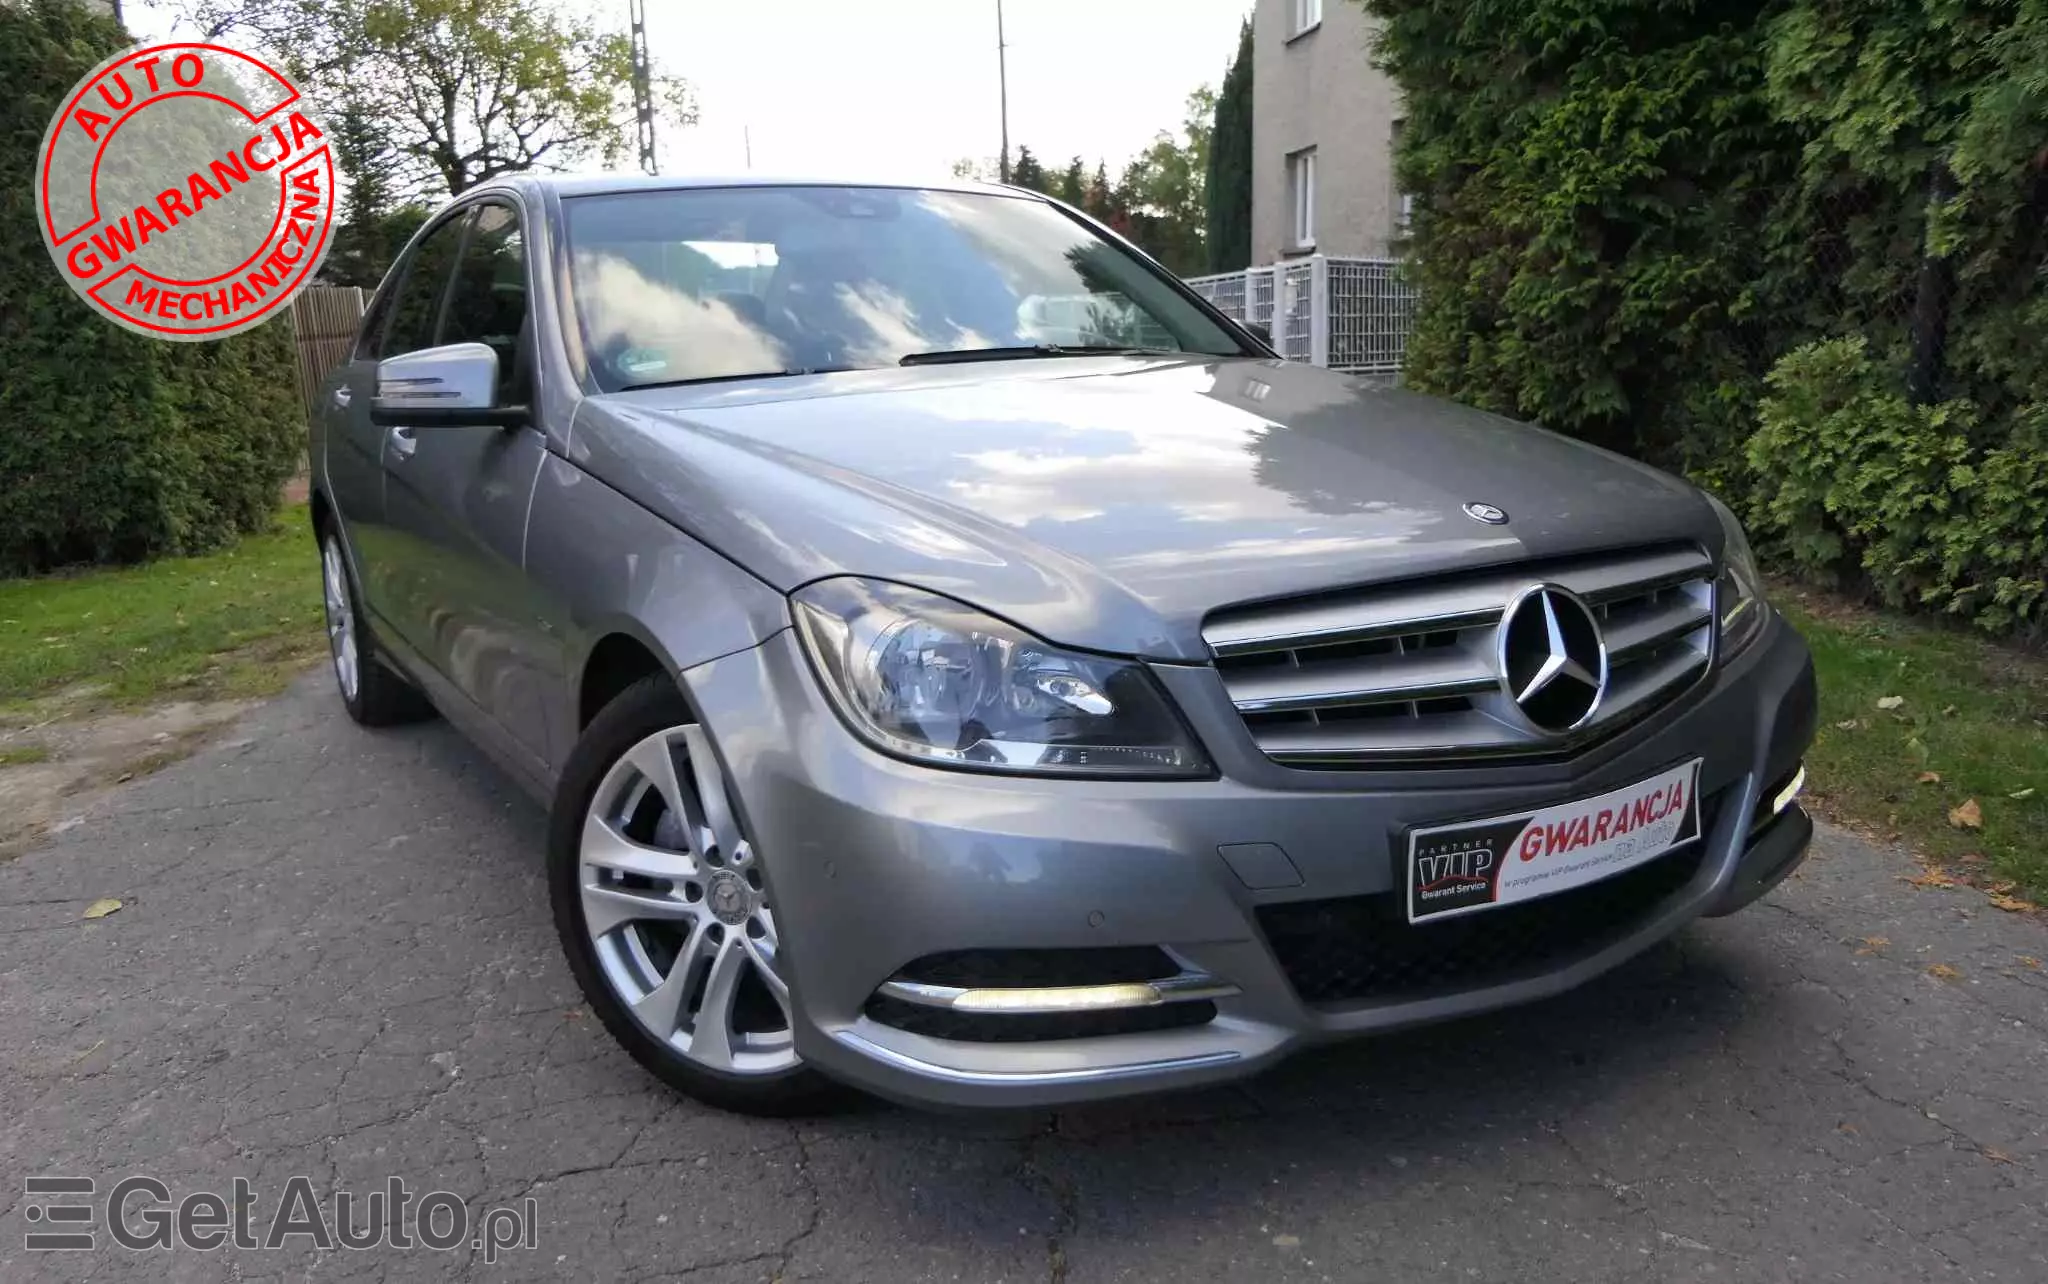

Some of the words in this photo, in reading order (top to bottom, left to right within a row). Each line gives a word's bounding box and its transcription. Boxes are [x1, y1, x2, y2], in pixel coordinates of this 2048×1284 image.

[1519, 779, 1683, 863] GWARANCJA
[1418, 848, 1493, 888] VIP
[1422, 886, 1455, 900] Gwarant
[1456, 881, 1487, 894] Service
